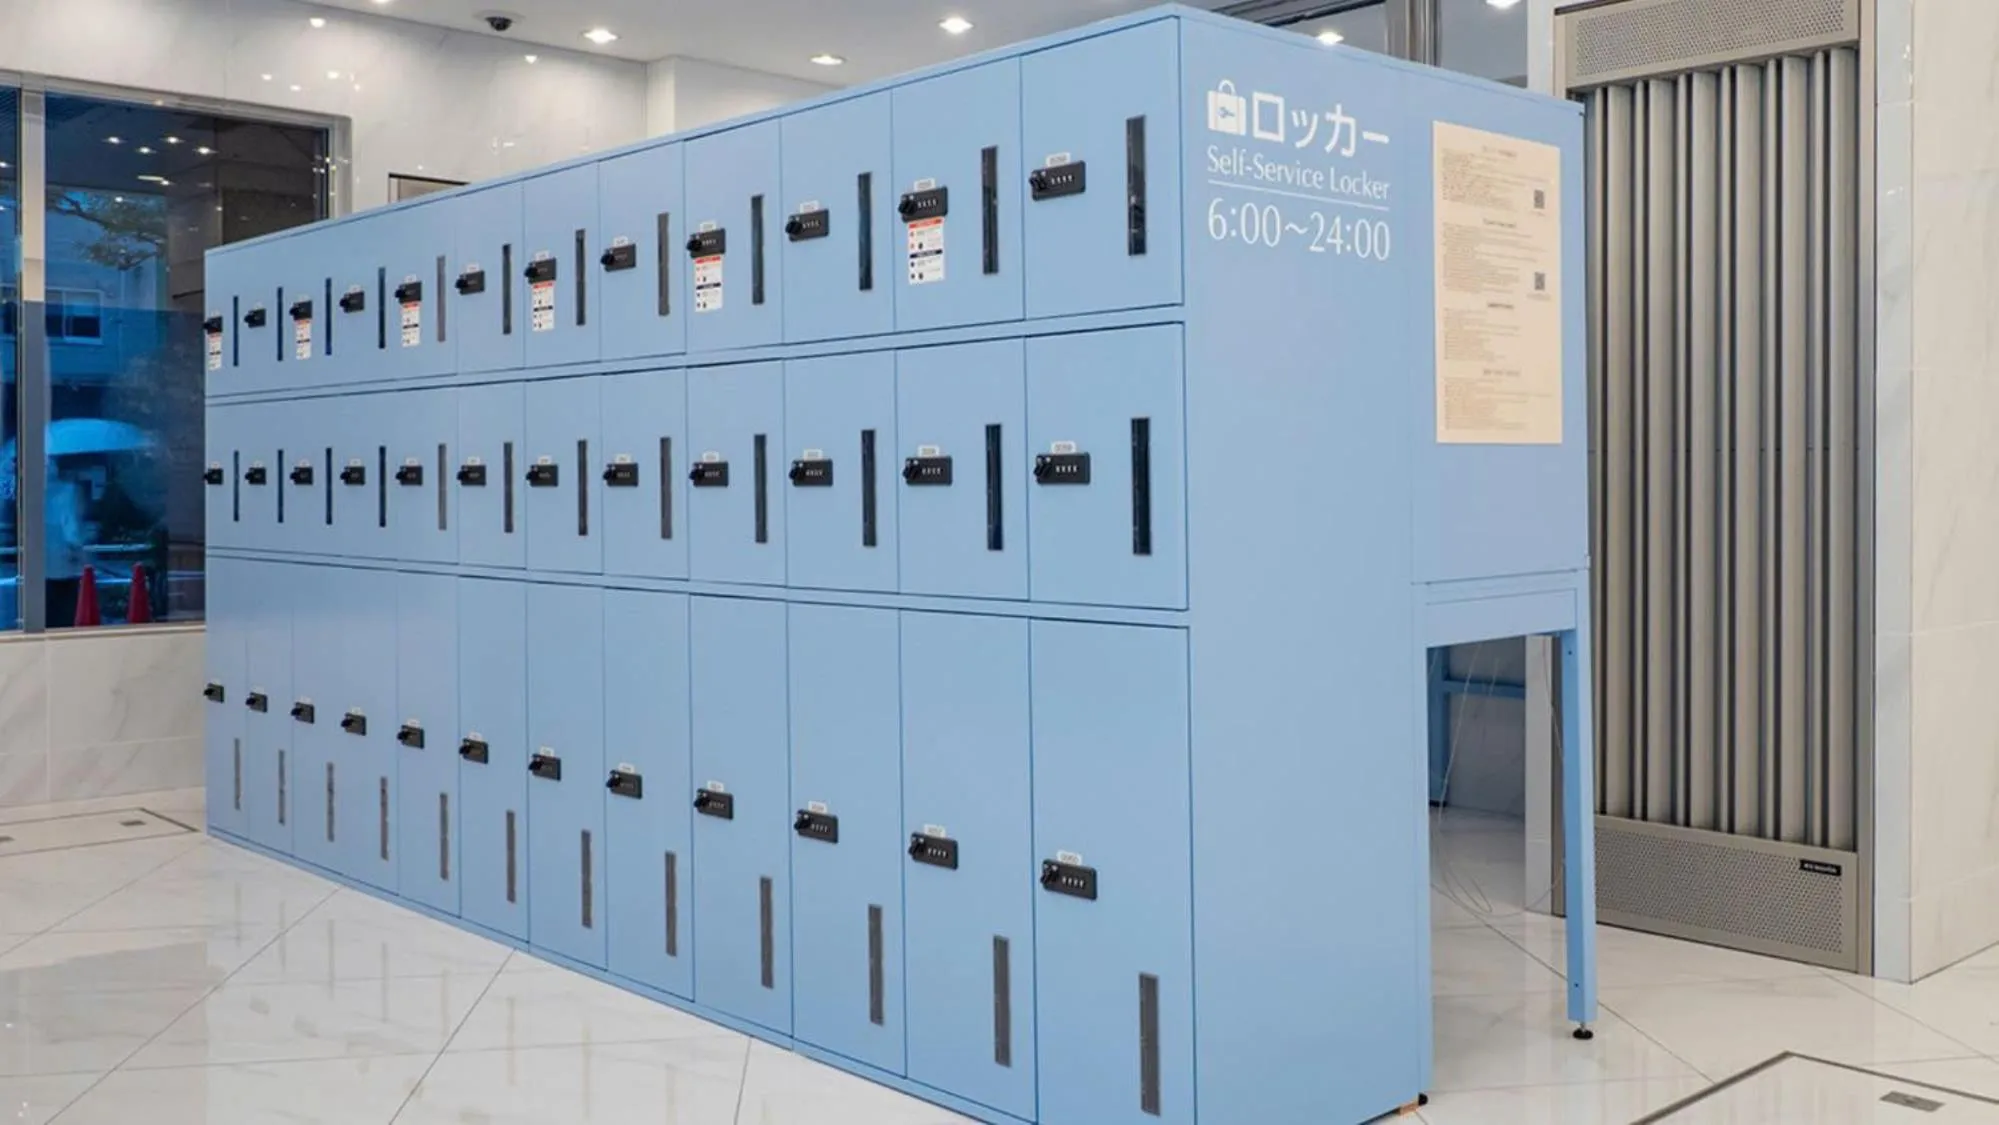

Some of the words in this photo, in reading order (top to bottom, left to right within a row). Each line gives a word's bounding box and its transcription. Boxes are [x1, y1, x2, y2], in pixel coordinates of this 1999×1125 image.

[1252, 91, 1390, 158] ロッカー
[1207, 144, 1325, 190] Self-Service
[1330, 166, 1390, 200] Locker
